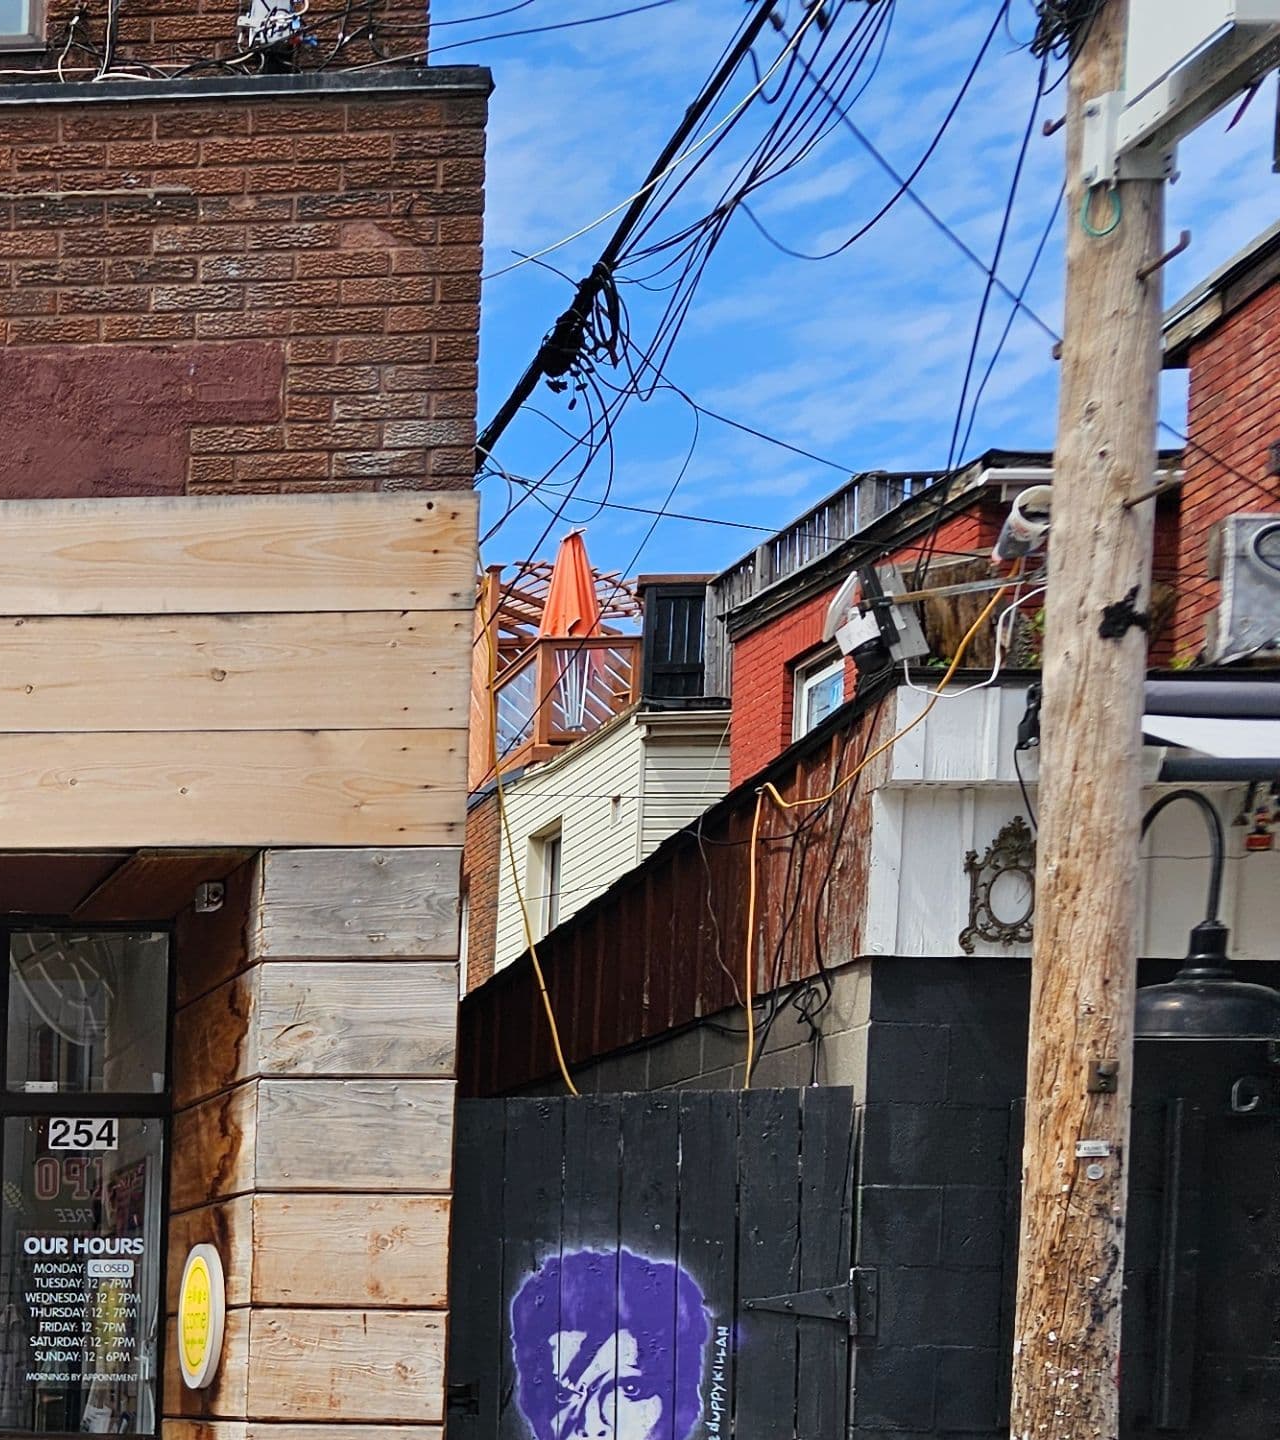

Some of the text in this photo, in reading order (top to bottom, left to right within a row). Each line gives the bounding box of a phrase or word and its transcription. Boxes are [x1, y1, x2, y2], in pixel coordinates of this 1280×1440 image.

[50, 1119, 117, 1148] 254
[23, 1237, 145, 1255] OUR HOURS
[33, 1263, 130, 1274] MONDAY: CLOSED
[34, 1278, 85, 1289] TUESDAY:
[87, 1278, 99, 1289] 12
[109, 1278, 133, 1289] 7PM
[25, 1293, 94, 1304] WEDNESDAY:
[96, 1293, 107, 1303] 12
[117, 1293, 142, 1304] 7PM
[29, 1307, 89, 1318] THURSDAY:
[92, 1307, 103, 1318] 12
[113, 1307, 137, 1318] 7PM
[39, 1322, 79, 1333] FRIDAY:
[81, 1322, 92, 1332] 12
[103, 1322, 127, 1333] 7PM
[29, 1336, 88, 1347] SATURDAY:
[90, 1336, 102, 1347] 12
[112, 1337, 136, 1347] 7PM
[34, 1351, 82, 1361] SUNDAY:
[84, 1351, 96, 1361] 12
[106, 1352, 131, 1362] 6PM
[26, 1373, 138, 1381] MORNINGS BY APPOINTMENT
